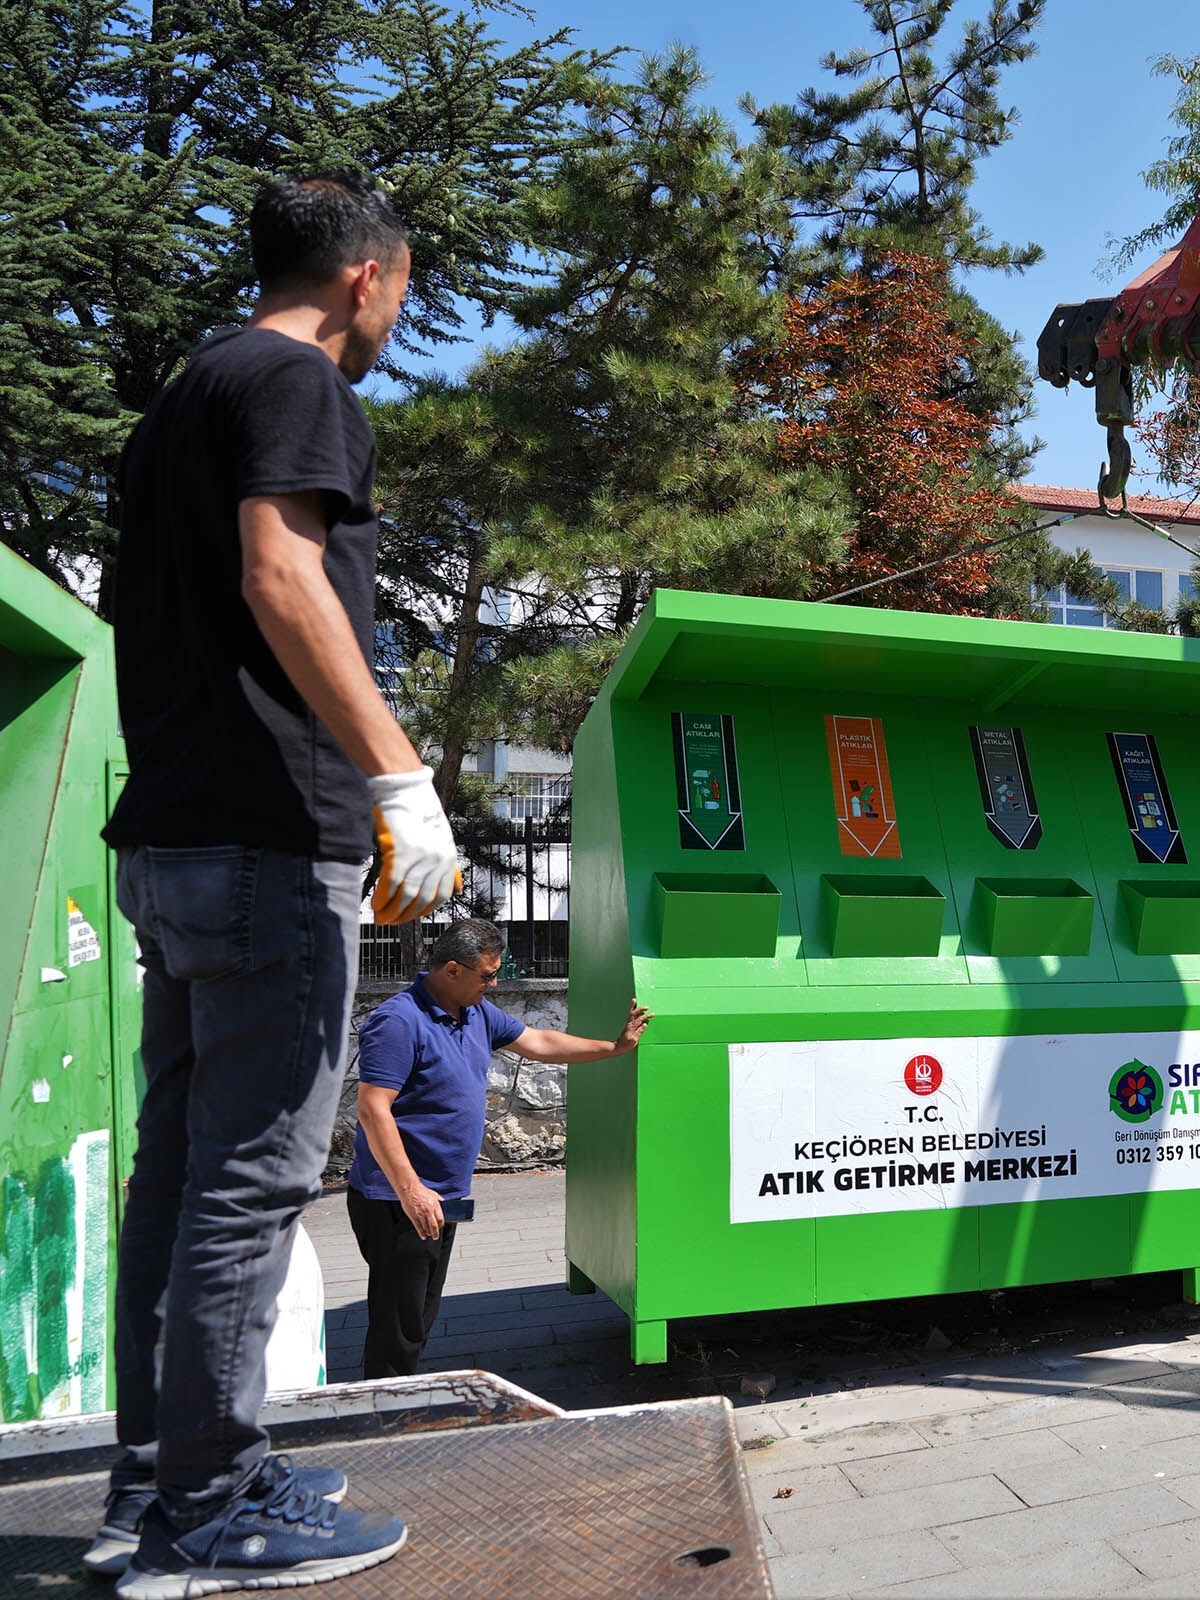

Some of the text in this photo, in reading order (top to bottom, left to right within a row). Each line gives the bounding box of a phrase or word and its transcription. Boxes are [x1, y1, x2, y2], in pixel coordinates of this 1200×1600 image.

[693, 722, 712, 730] CAM
[686, 730, 721, 738] ATIKLAR
[984, 731, 1008, 739] METAL
[840, 741, 873, 749] ATIKLAR
[1123, 757, 1151, 765] ATIKLAR
[904, 1105, 944, 1123] T.C.
[1115, 1131, 1132, 1142] Geri
[1134, 1128, 1170, 1142] Dönüşüm
[794, 1124, 1047, 1163] KEÇİÖREN BELEDİYESİ
[1116, 1147, 1151, 1164] 0312
[1156, 1145, 1183, 1161] 359
[758, 1149, 1077, 1197] ATIK GETİRME MERKEZİ
